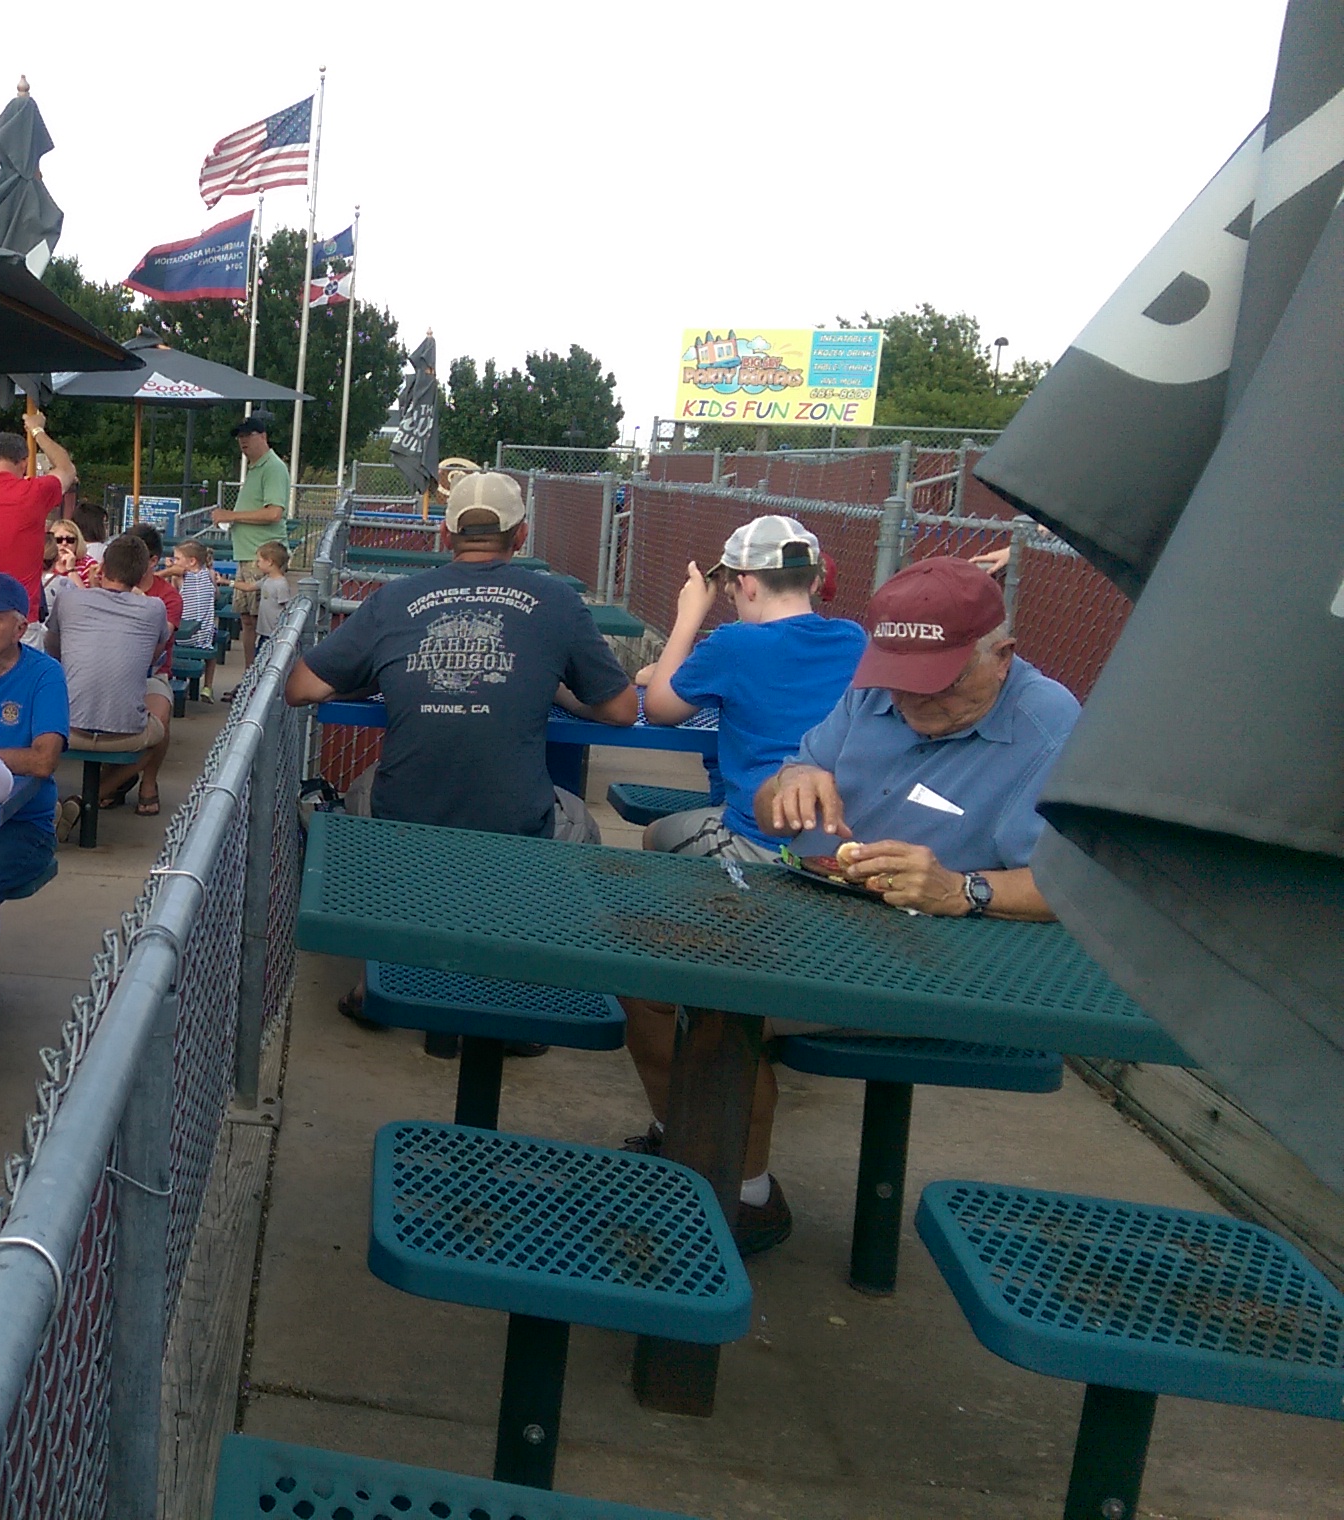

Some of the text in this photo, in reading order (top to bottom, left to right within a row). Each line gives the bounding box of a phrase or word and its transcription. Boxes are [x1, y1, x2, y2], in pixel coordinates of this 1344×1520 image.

[683, 366, 736, 385] PARTY
[141, 380, 203, 392] Coors
[809, 388, 871, 400] 685-8600
[682, 400, 859, 422] KIDS FUN ZONE
[407, 586, 540, 614] ORANGE COUNTY
[410, 595, 534, 619] HARLEY-DAVIDSON
[873, 621, 946, 641] ANDOVER
[418, 635, 503, 655] HARLEY
[406, 651, 516, 674] DAVIDSON
[420, 703, 491, 715] IRVINE, CA
